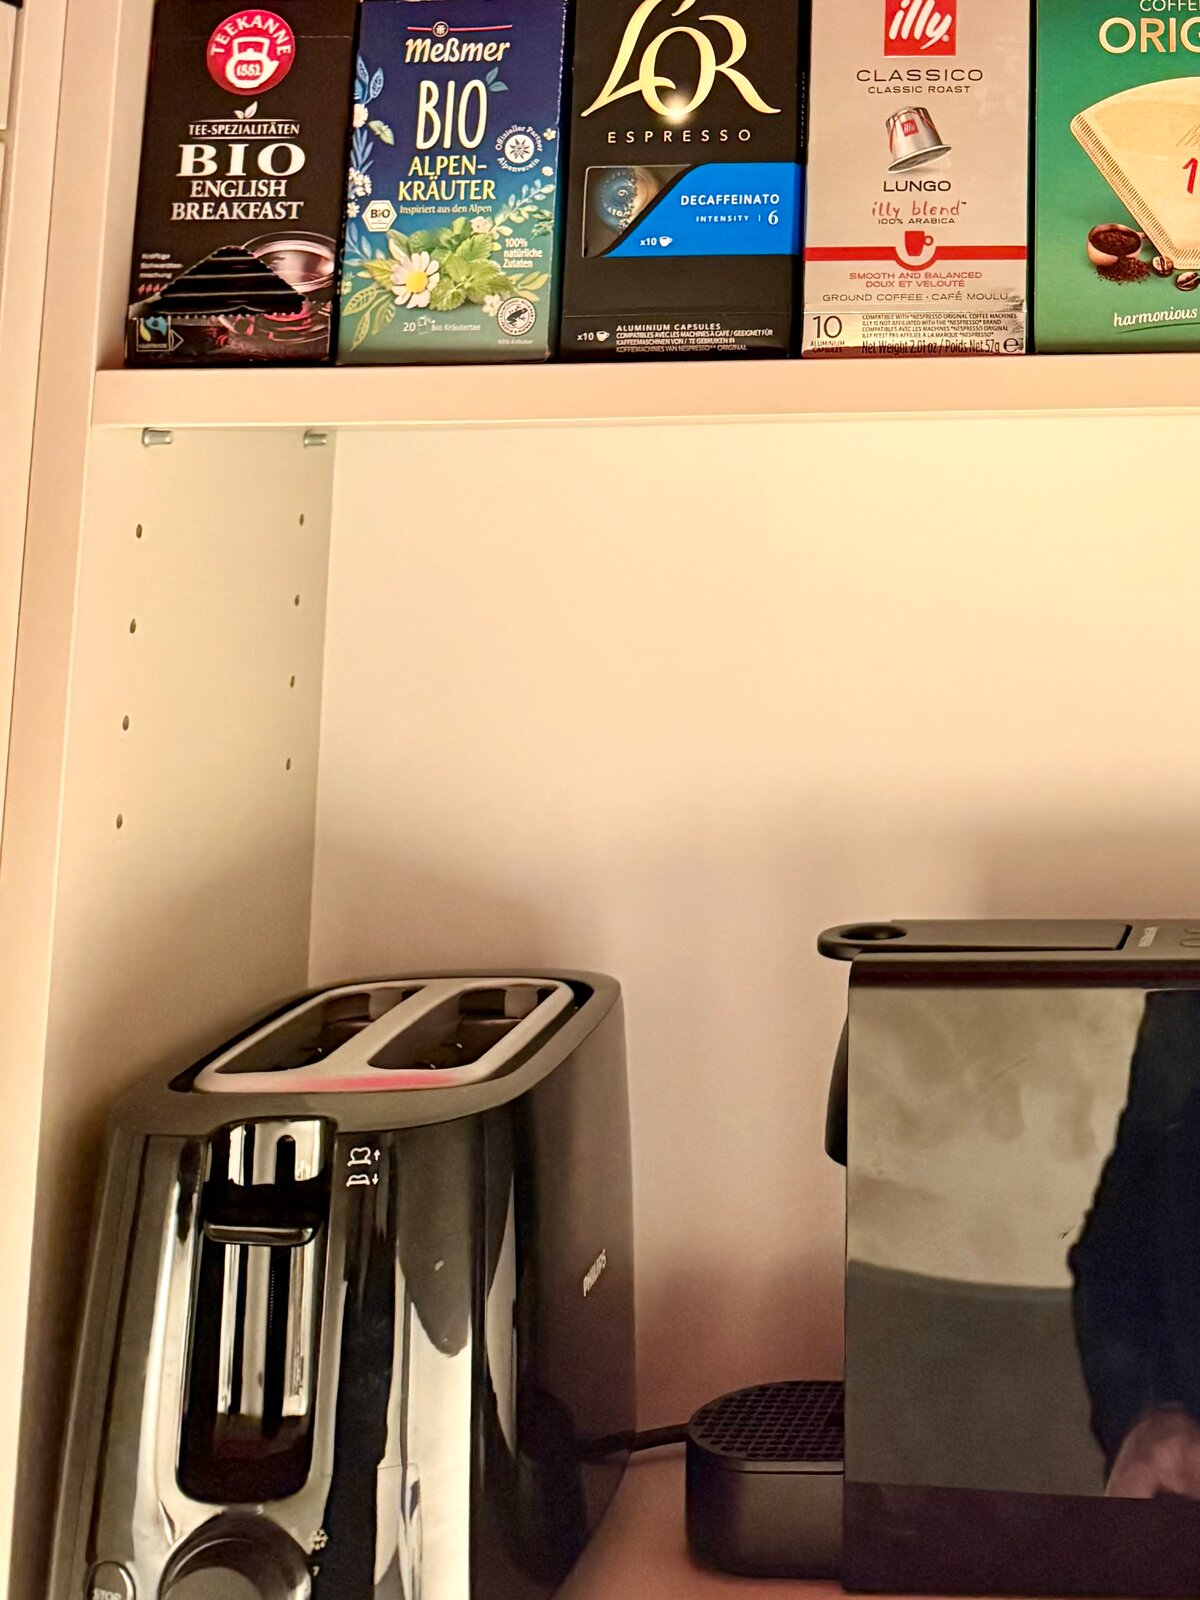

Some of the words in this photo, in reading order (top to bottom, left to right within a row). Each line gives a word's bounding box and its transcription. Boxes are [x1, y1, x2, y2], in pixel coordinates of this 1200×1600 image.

[210, 14, 292, 56] TEEKANNE
[404, 37, 511, 64] Meßmer
[236, 63, 261, 77] 1882
[856, 69, 983, 82] CLASSICO
[867, 85, 923, 94] CLASSIC
[928, 85, 971, 93] ROAST
[416, 79, 488, 150] BIO
[188, 121, 300, 136] TEE-SPEZIALITÄTEN
[607, 128, 752, 144] ESPRESSO
[175, 143, 306, 177] BIO
[408, 155, 488, 177] ALPEN-
[189, 179, 288, 198] ENGLISH
[398, 175, 497, 202] KRÄUTER
[883, 180, 952, 192] LUNGO
[680, 193, 780, 206] DECAFFEINATO
[170, 201, 304, 221] BREAKFAST
[399, 205, 436, 216] Inspiriert
[451, 204, 467, 214] den
[468, 203, 493, 215] Alpen
[872, 201, 901, 219] illy
[695, 214, 749, 222] INTENSITY
[767, 209, 779, 226] 6
[878, 217, 904, 225] 100%
[908, 217, 956, 225] ARABICA
[504, 237, 528, 248] 100%
[639, 237, 657, 246] x10
[503, 248, 543, 259] natürliche
[502, 258, 533, 269] Zutaten
[849, 272, 896, 280] SMOOTH
[898, 272, 921, 280] AND
[924, 271, 983, 279] BALANCED
[865, 280, 896, 288] DOUX
[899, 280, 913, 288] ET
[915, 279, 966, 288] VELOUTÉ
[822, 293, 873, 302] GROUND
[876, 293, 923, 301] COFFEE
[931, 291, 962, 301] CAFÉ
[966, 293, 1008, 301] MOULU
[1113, 306, 1198, 328] harmonious
[403, 321, 416, 332] 20
[616, 324, 671, 332] ALUMINIUM
[674, 323, 721, 331] CAPSULES
[813, 315, 843, 339] 10
[576, 332, 595, 341] x10
[861, 340, 877, 354] Net
[878, 339, 910, 356] Weight
[909, 339, 926, 354] 2.01
[927, 342, 938, 354] oz
[945, 338, 968, 353] Poids
[969, 338, 983, 353] Net
[985, 338, 1000, 355] 57g
